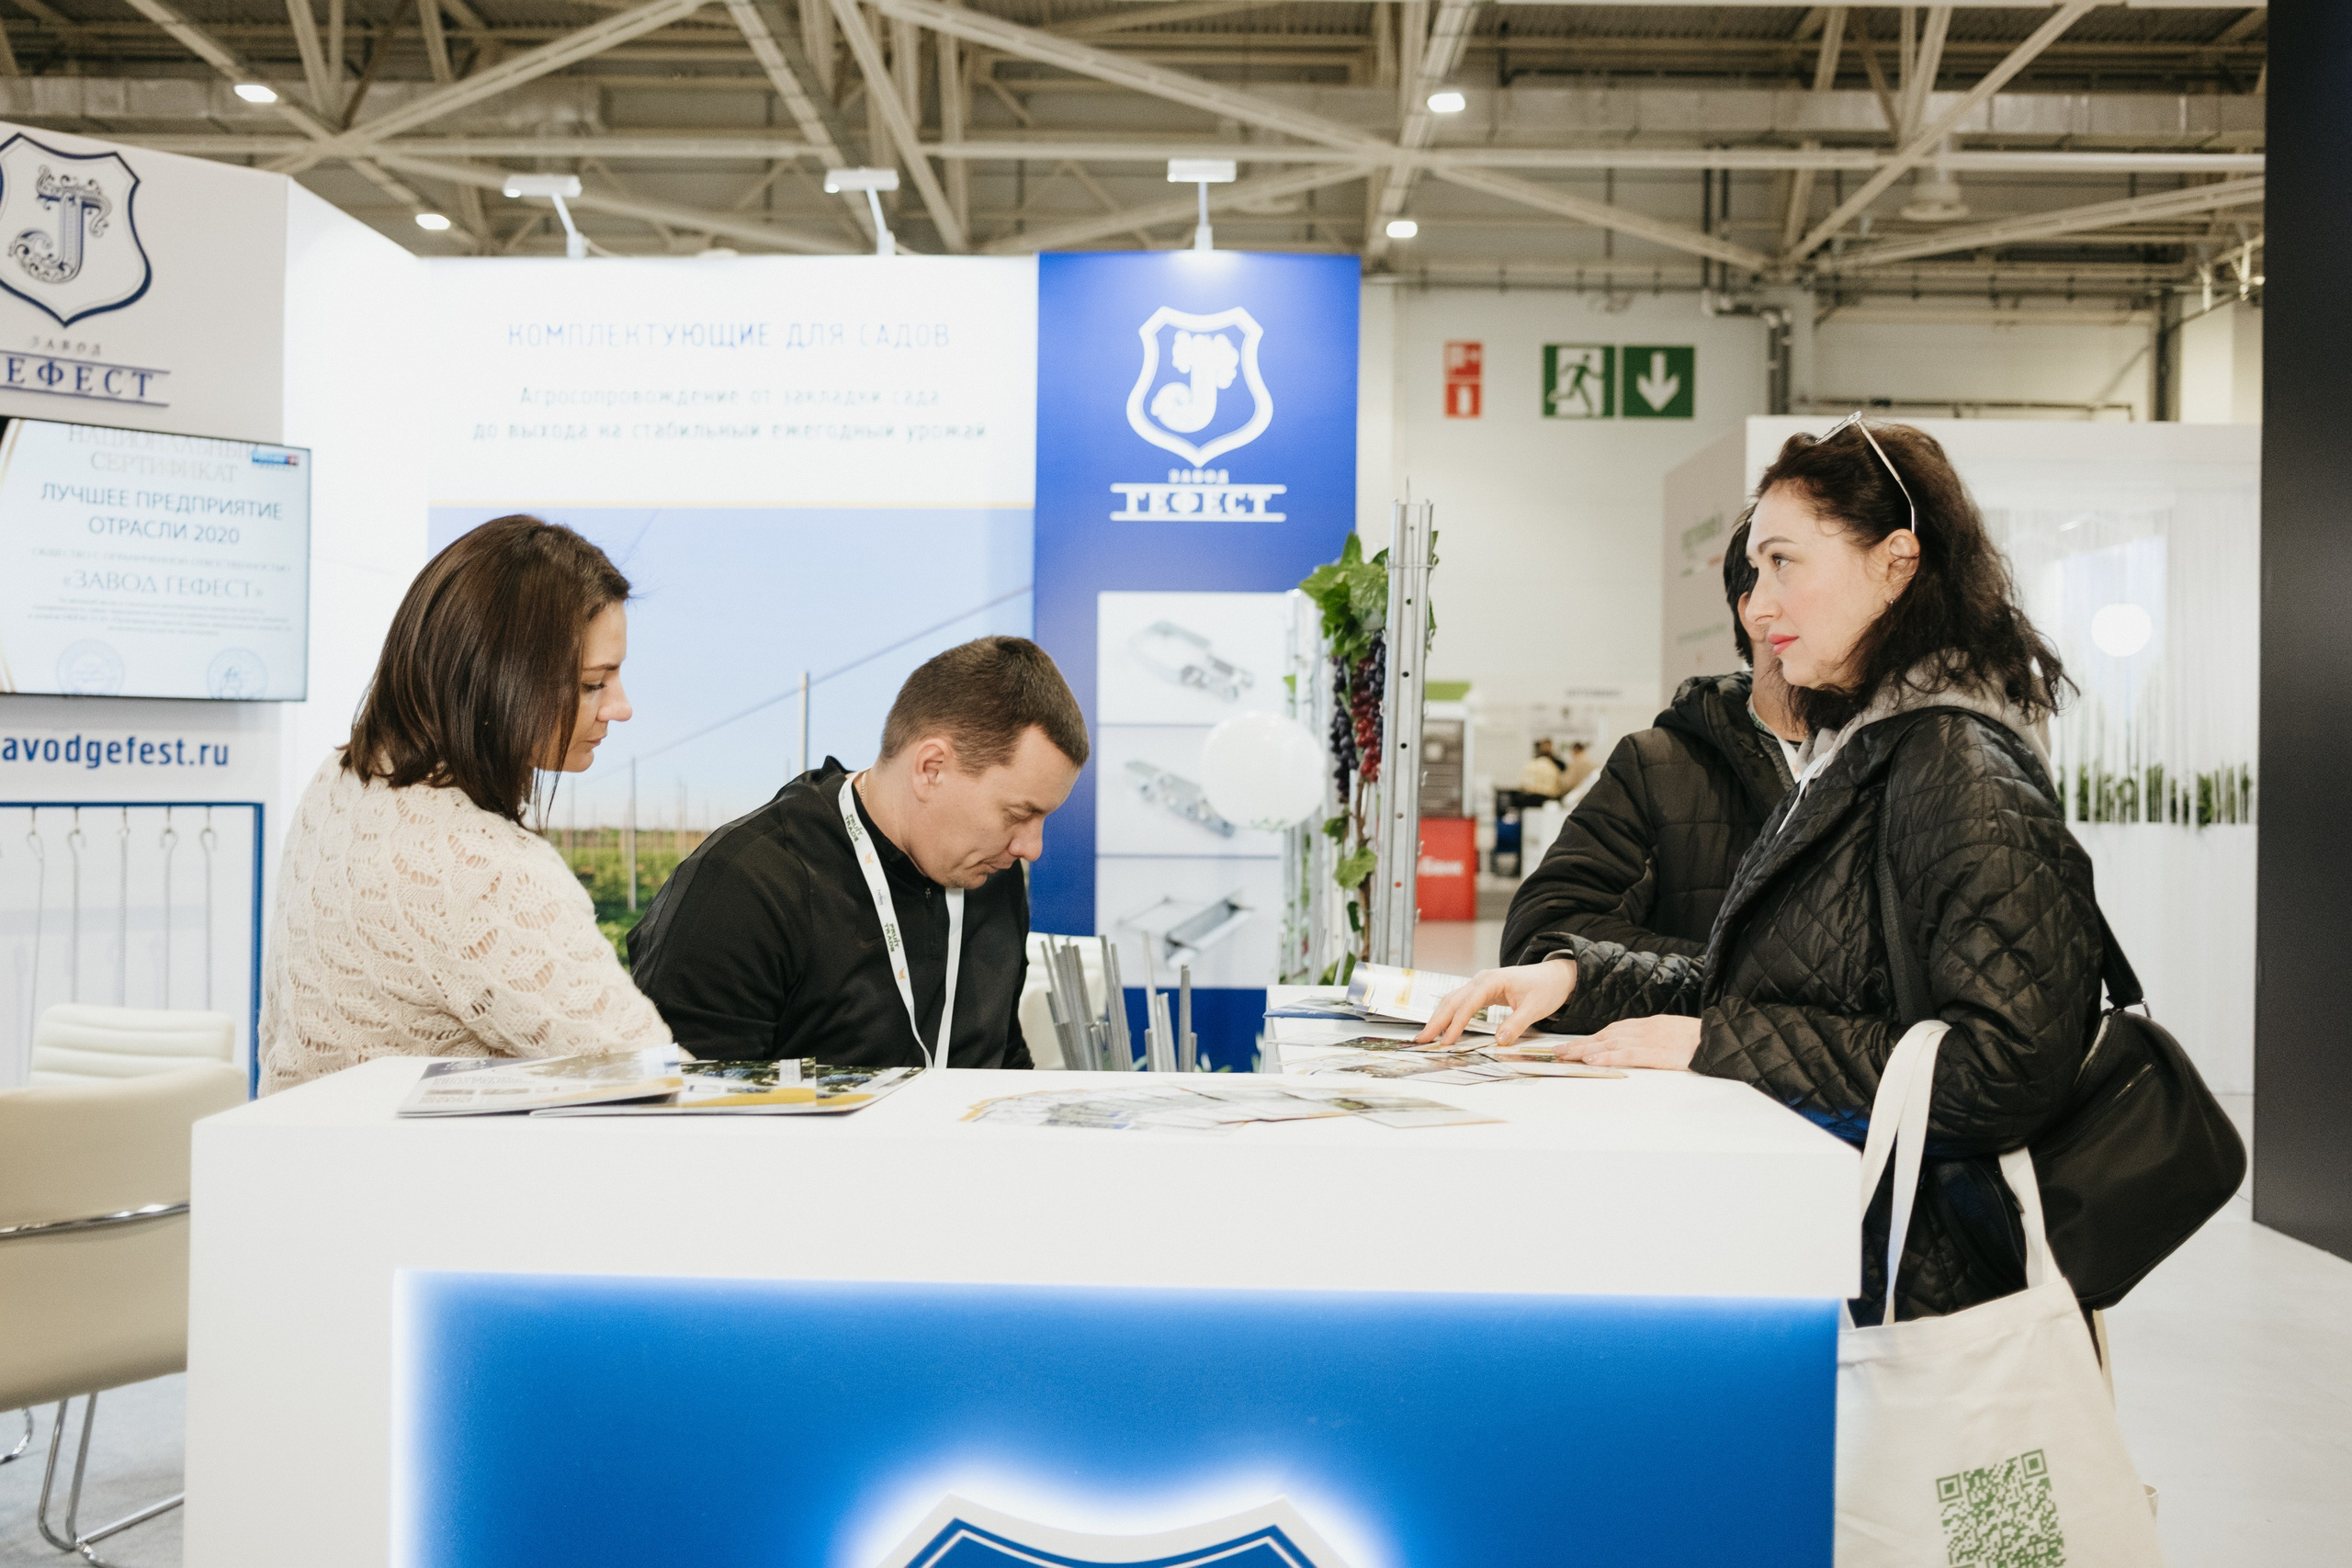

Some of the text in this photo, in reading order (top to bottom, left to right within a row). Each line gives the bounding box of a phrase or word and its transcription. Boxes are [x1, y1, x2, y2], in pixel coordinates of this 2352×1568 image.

[508, 323, 950, 348] КОМПЛЕКТУЮЩИЕ ДЛЯ САДОВ
[6, 356, 153, 398] ЕФЕСТ
[751, 389, 771, 404] от
[472, 423, 498, 440] до
[509, 423, 588, 440] выхода
[632, 421, 760, 439] стабильный
[90, 450, 239, 483] СЕРТИФИКАТ
[40, 482, 283, 521] ЛУЧШЕЕ ПРЕДПРИЯТИЕ
[88, 516, 241, 545] ОТРАСЛИ 2020
[2, 734, 229, 769] avodgefest.ru
